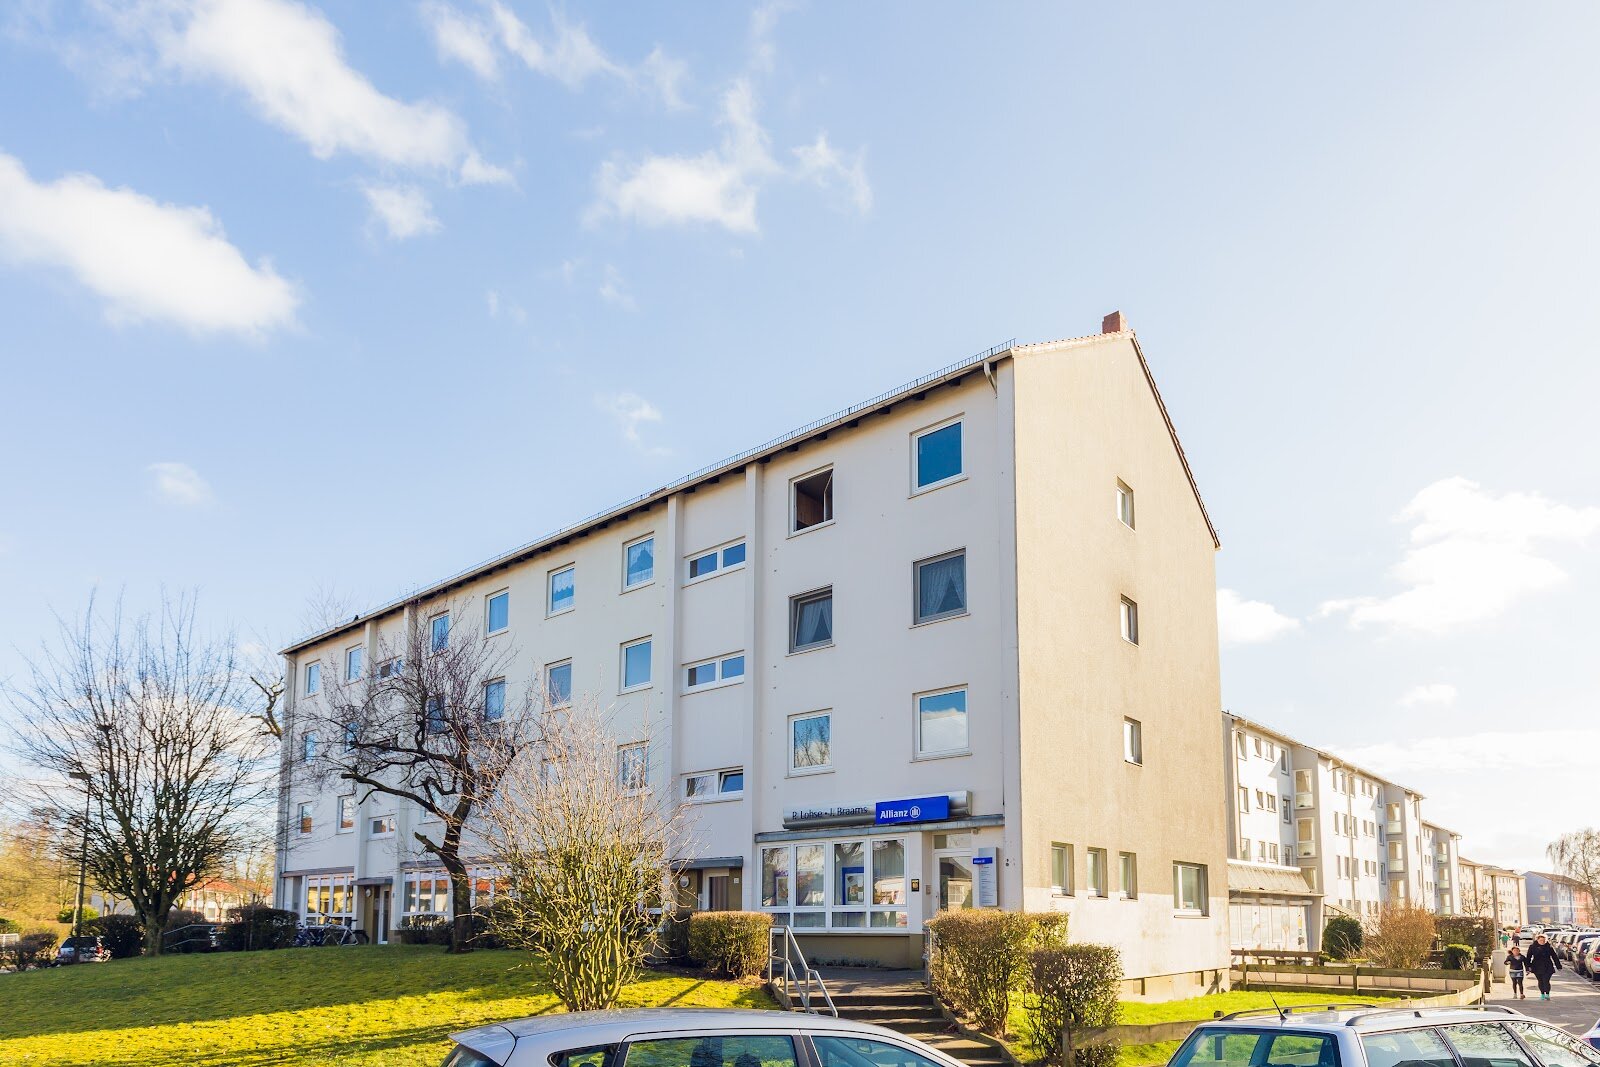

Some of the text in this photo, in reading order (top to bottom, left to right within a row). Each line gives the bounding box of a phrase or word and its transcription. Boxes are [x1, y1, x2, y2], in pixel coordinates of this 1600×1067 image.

[800, 809, 823, 820] Lohse
[837, 806, 868, 816] Braams
[880, 809, 909, 819] Allianz
